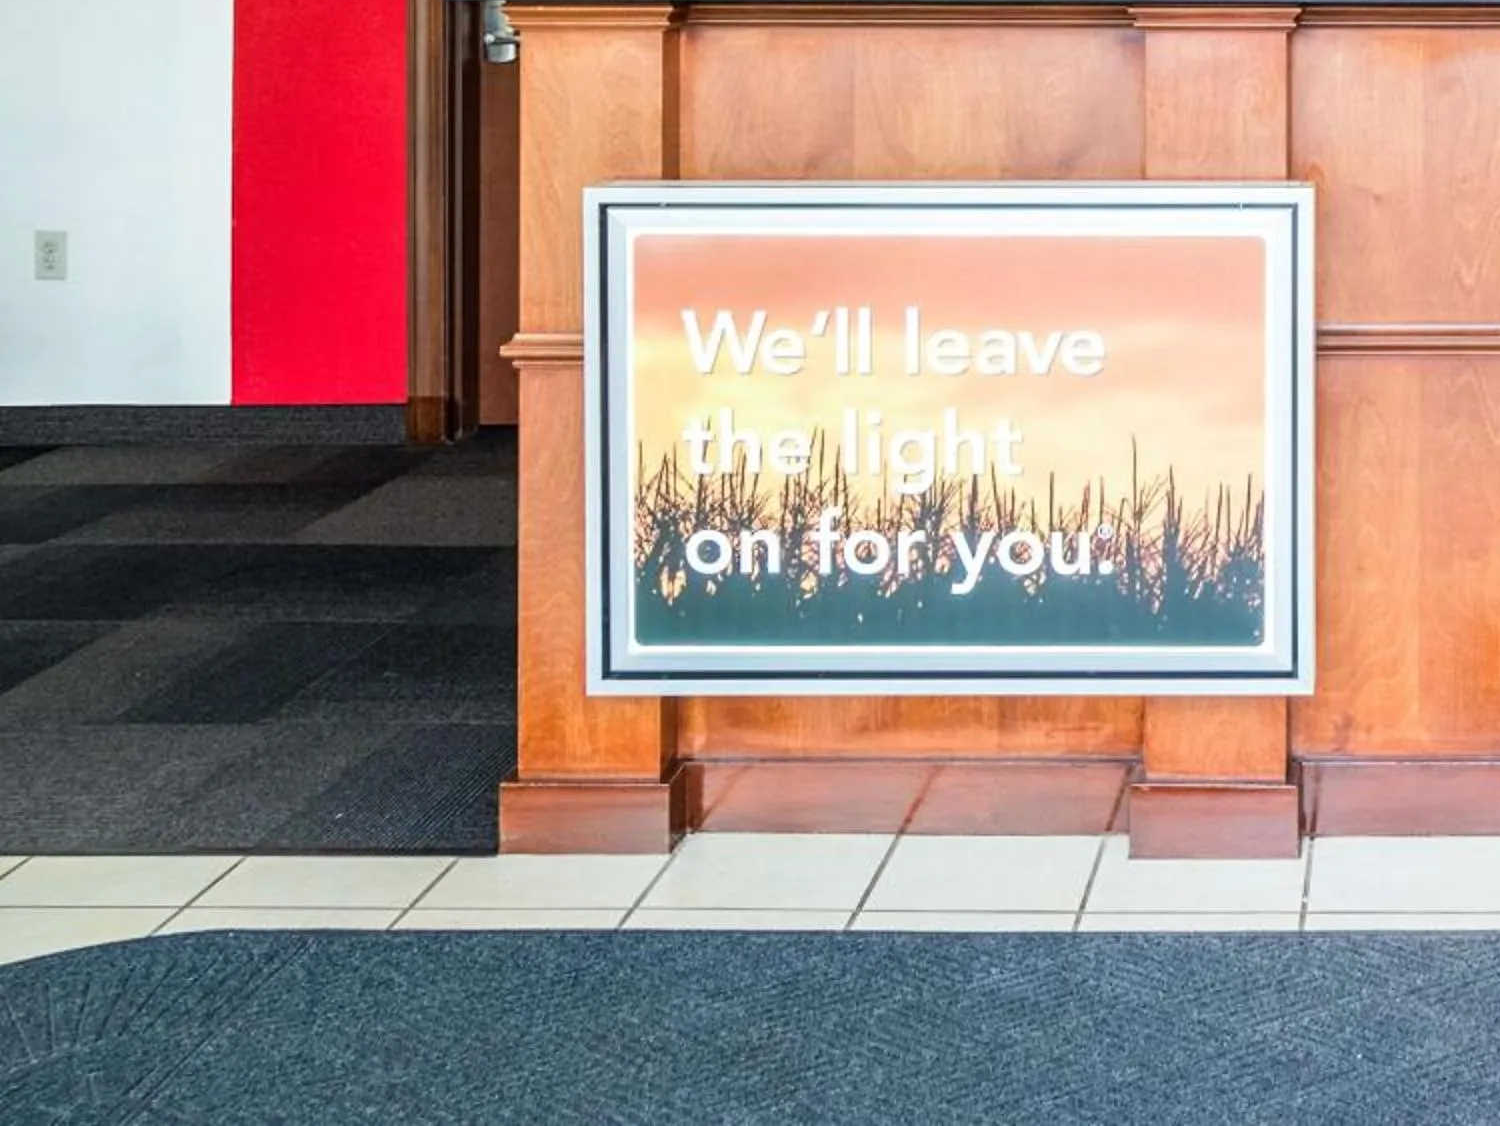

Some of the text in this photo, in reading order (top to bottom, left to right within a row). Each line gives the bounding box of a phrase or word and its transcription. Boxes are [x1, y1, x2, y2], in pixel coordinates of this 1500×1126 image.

[681, 306, 1107, 376] We'll leave
[682, 408, 1024, 495] the light
[684, 527, 782, 575] on
[817, 506, 926, 576] for
